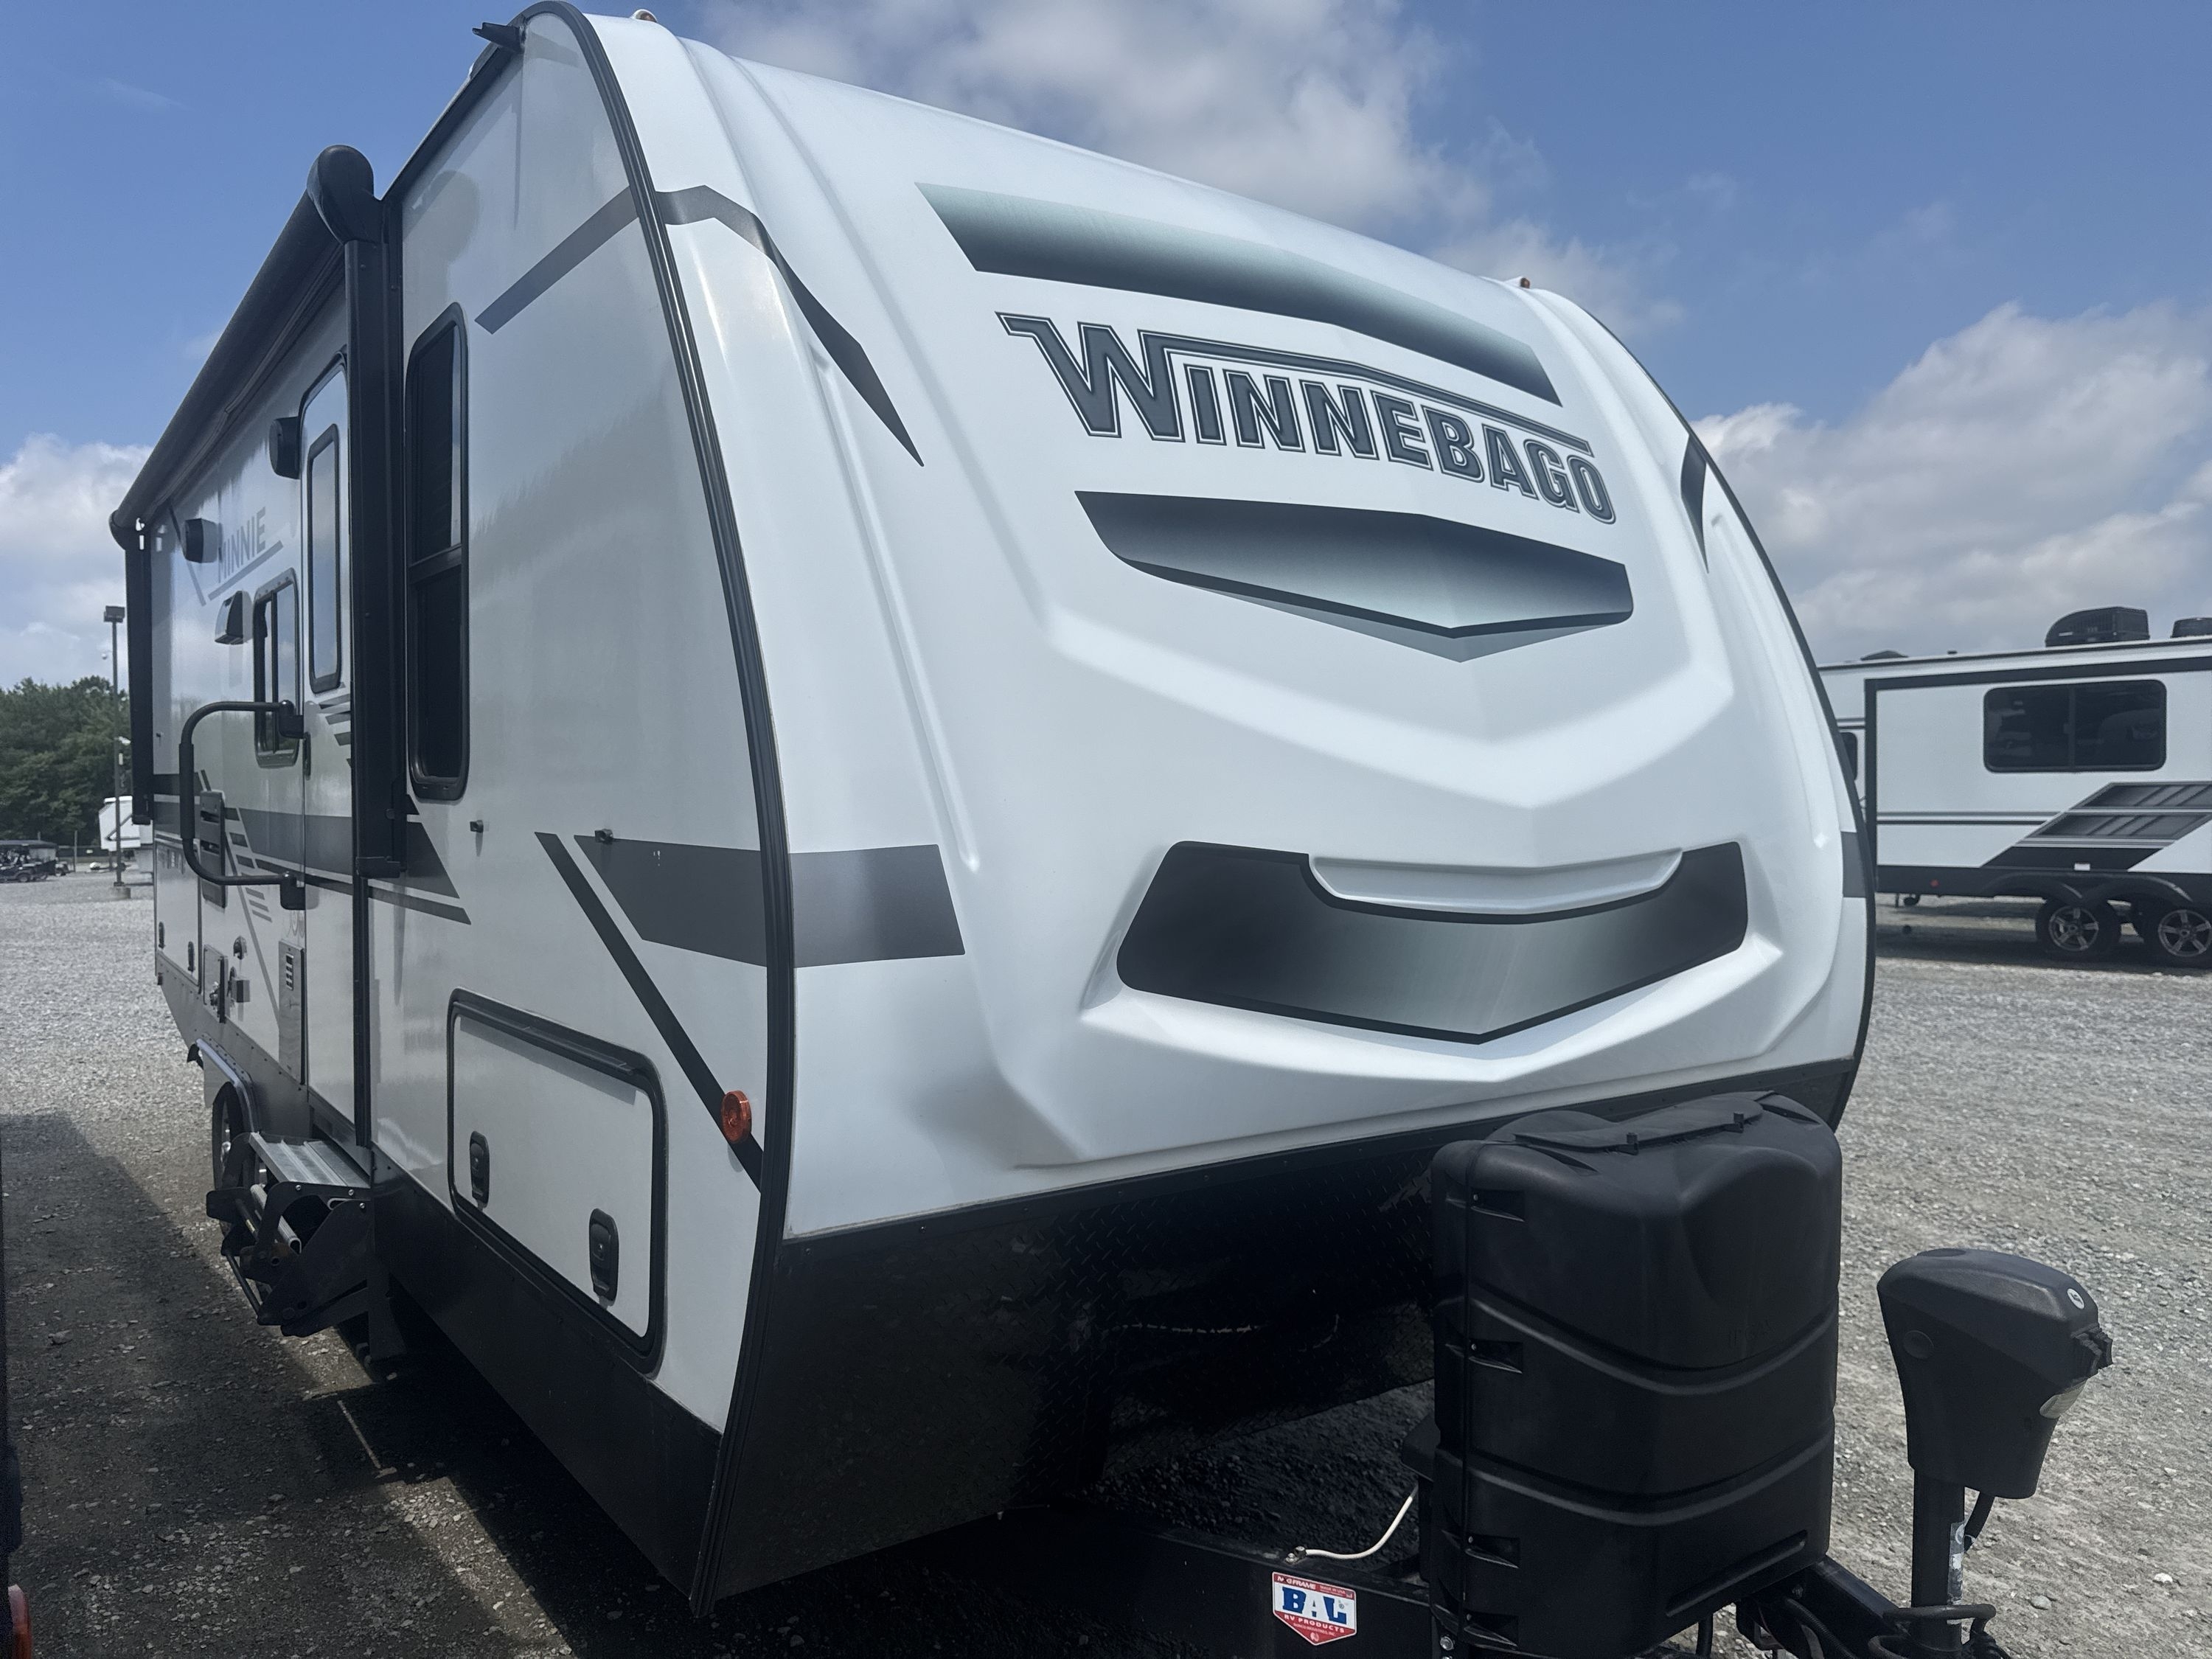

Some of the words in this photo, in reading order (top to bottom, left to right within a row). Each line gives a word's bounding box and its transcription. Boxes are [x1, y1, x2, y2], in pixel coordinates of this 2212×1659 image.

[995, 310, 1617, 526] WINNEBAGO
[1281, 1586, 1347, 1625] BAL
[1284, 1613, 1295, 1621] RV
[1298, 1617, 1345, 1633] PRODUCTS
